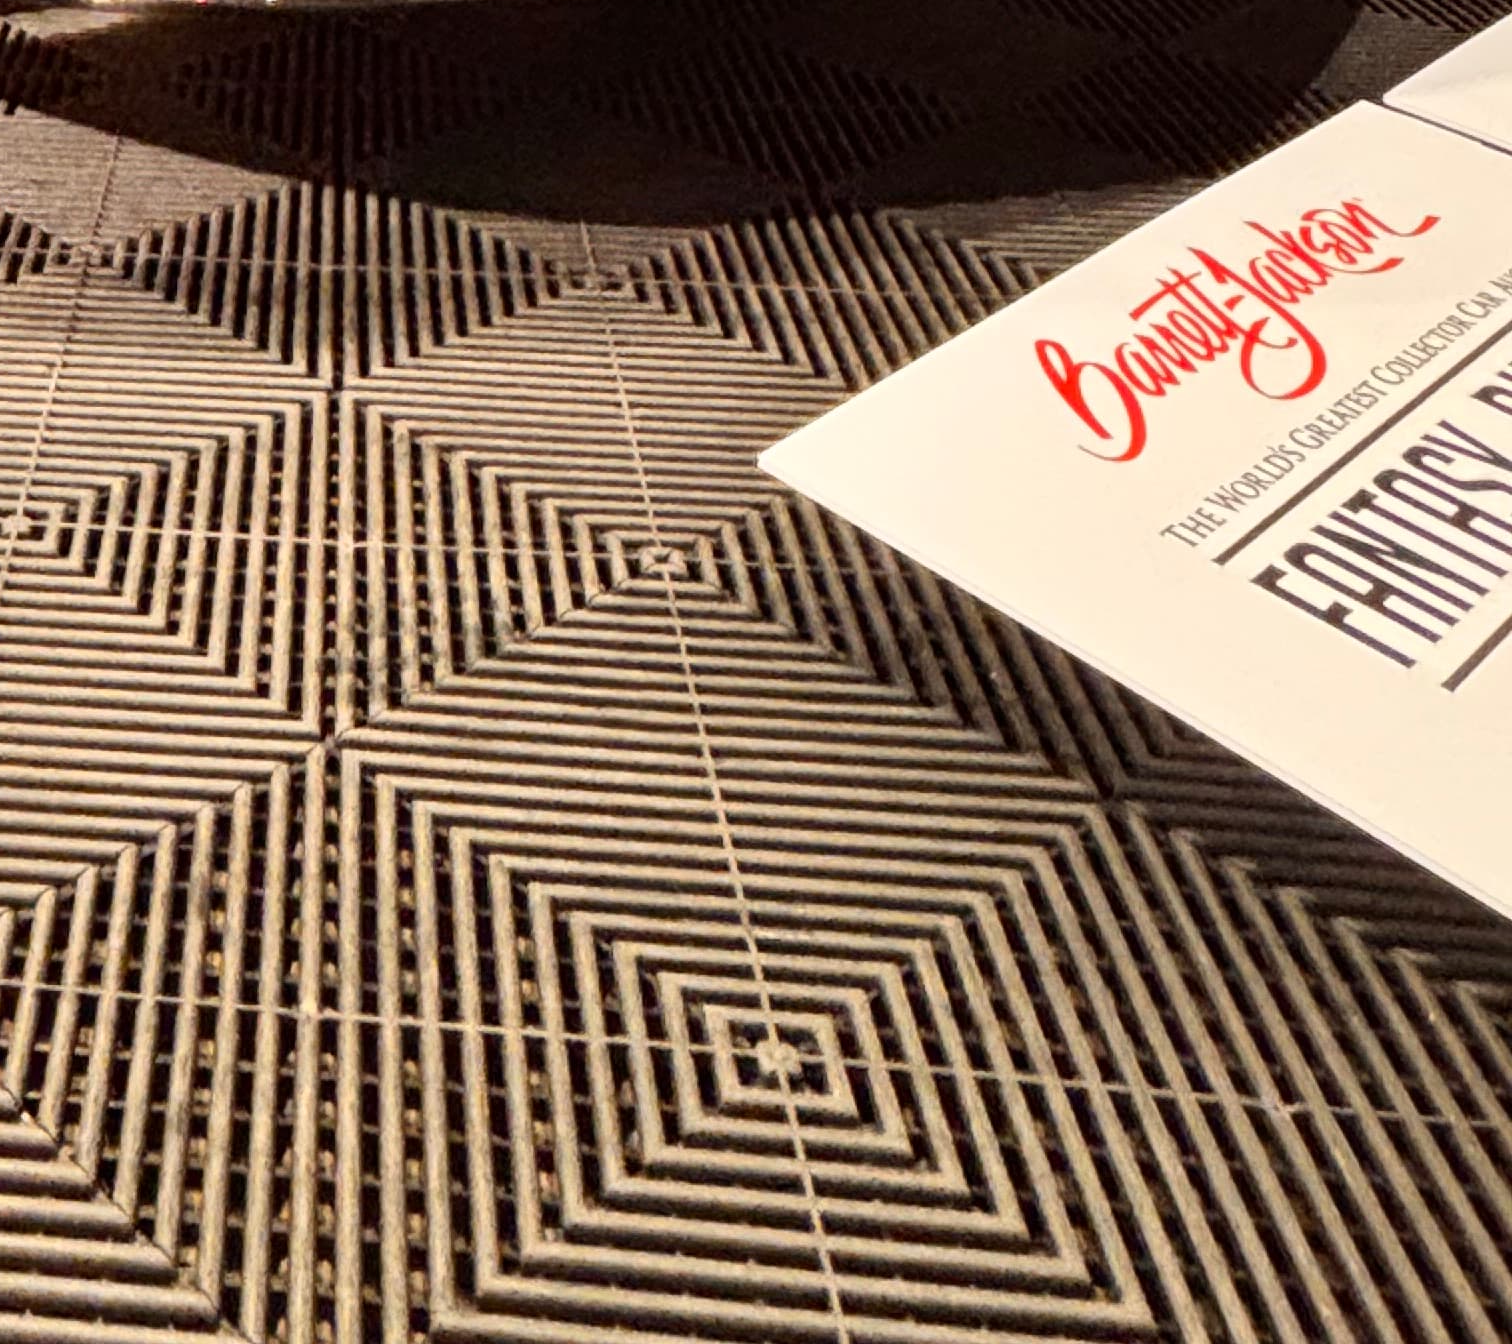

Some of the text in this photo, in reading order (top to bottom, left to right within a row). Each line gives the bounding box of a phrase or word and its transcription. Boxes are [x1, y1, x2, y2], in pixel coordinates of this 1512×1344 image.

[1034, 197, 1442, 463] Barrett-Jackson
[1159, 504, 1227, 548] THE
[1204, 444, 1307, 515] WORLD'S
[1288, 379, 1389, 451] GREATEST
[1369, 314, 1478, 387] COLLECTOR
[1455, 291, 1508, 320] CAR
